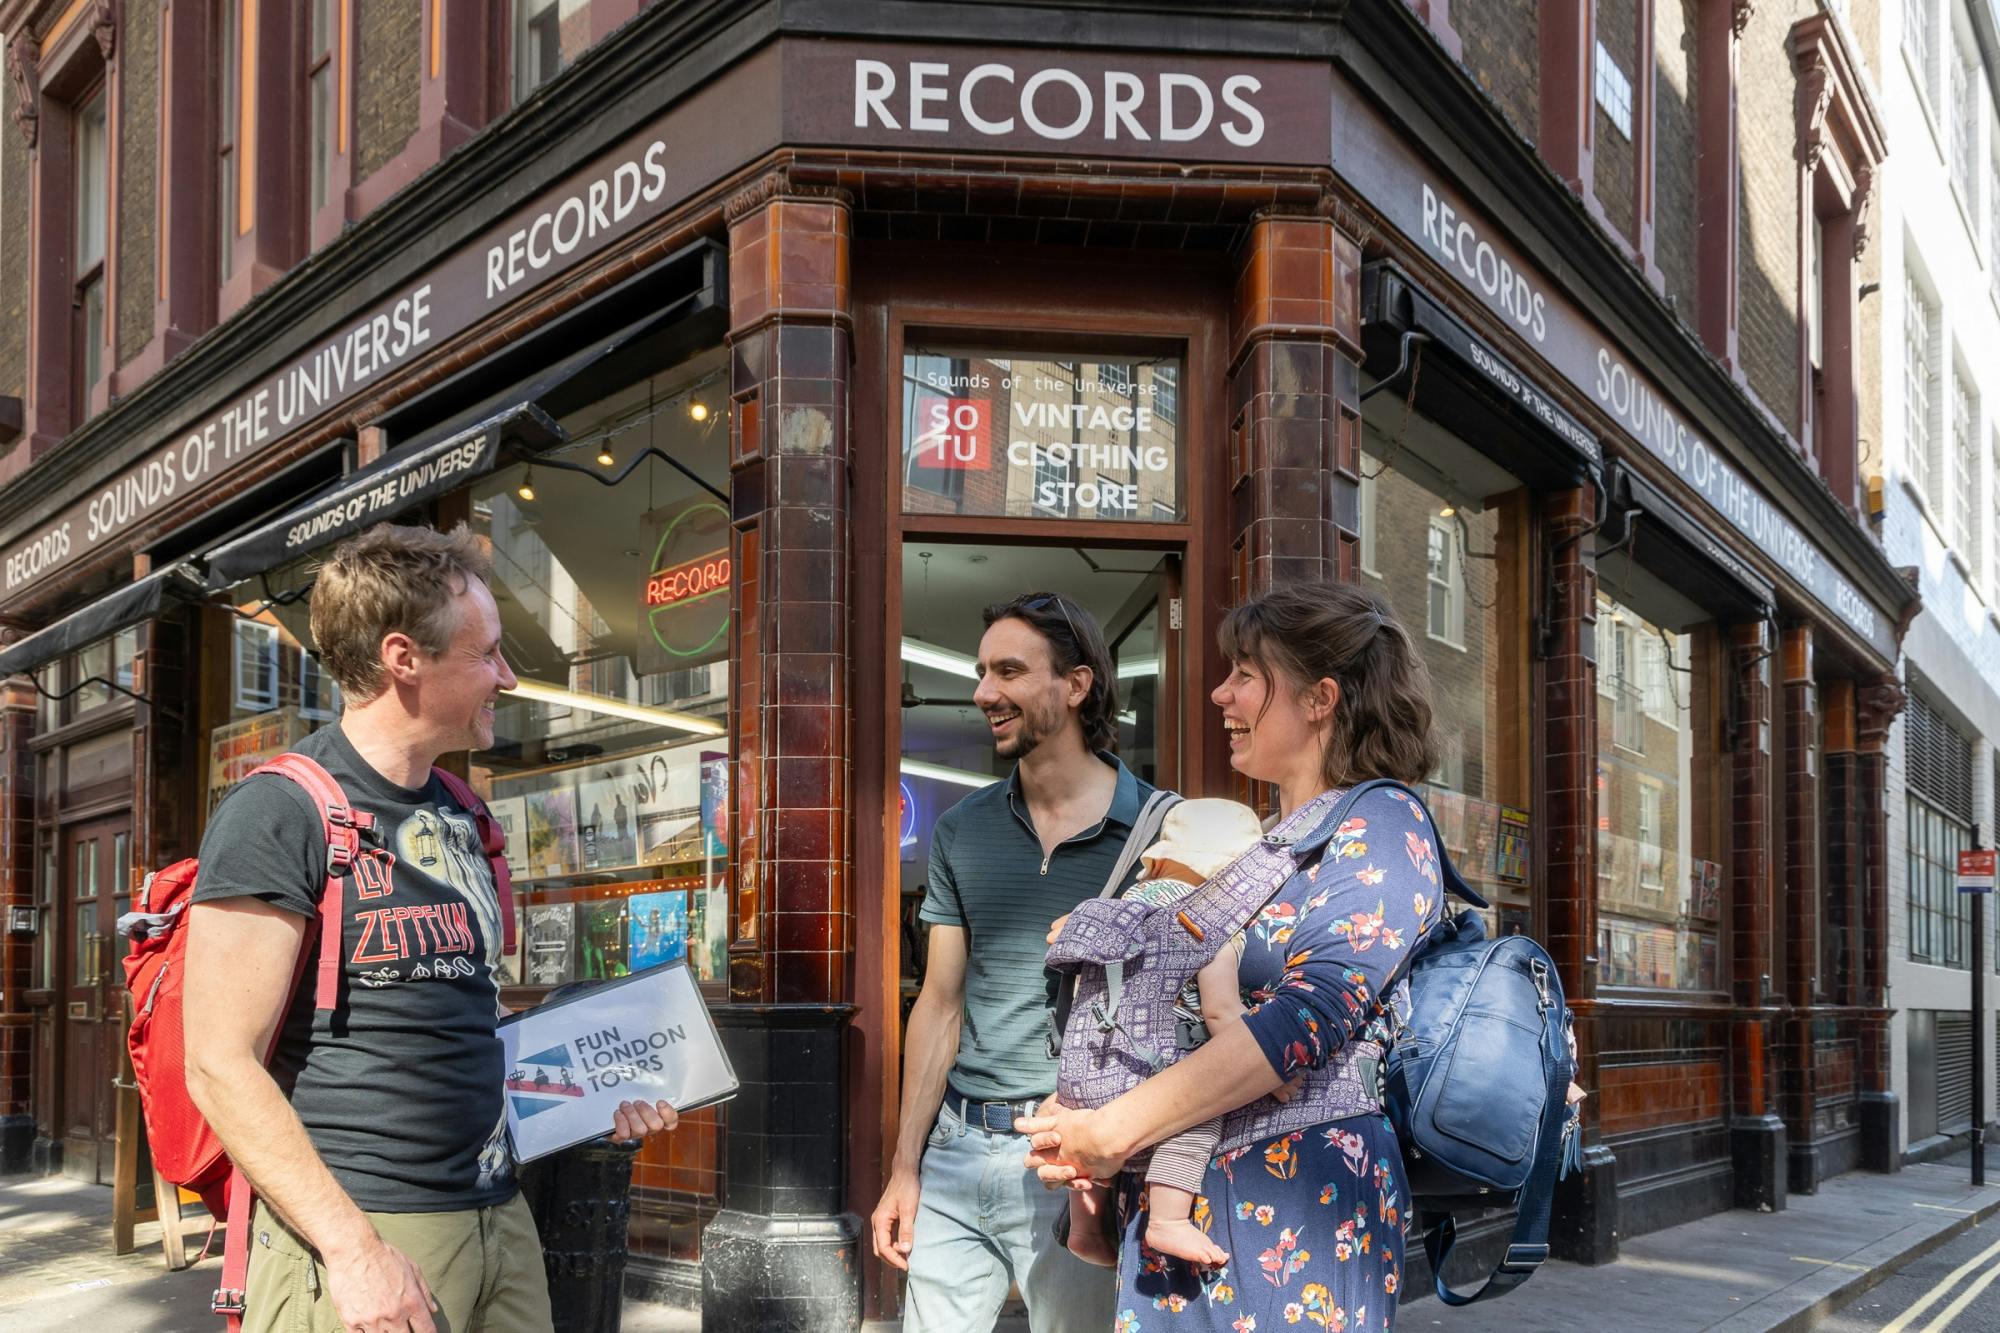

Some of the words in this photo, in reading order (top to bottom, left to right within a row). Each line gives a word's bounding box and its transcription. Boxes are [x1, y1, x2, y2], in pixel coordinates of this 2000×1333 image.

[854, 59, 1265, 147] RECORDS
[486, 141, 666, 299] RECORDS
[1422, 183, 1546, 342] RECORDS
[927, 371, 990, 388] Sounds
[1002, 375, 1022, 388] of
[1034, 378, 1064, 392] the
[1075, 378, 1158, 395] Universe
[87, 451, 175, 542] SOUNDS
[182, 429, 216, 482] OF
[222, 389, 270, 459] THE
[277, 285, 431, 425] UNIVERSE
[930, 404, 978, 431] SO
[1014, 402, 1152, 432] VINTAGE
[1532, 394, 1554, 424] THE
[935, 434, 977, 461] TU
[1007, 441, 1168, 471] CLOTHING
[1596, 348, 1687, 472] SOUNDS
[1692, 441, 1717, 496] OF
[1720, 466, 1749, 527] THE
[1753, 497, 1816, 587] UNIVERSE
[286, 503, 346, 548] SOUNDS
[346, 495, 367, 522] OF
[368, 479, 398, 513] THE
[399, 435, 487, 497] UNIVERSE
[1039, 481, 1138, 510] STORE
[6, 523, 71, 590] RECORDS
[647, 559, 730, 604] RECORD
[1835, 579, 1875, 639] RECORDS
[351, 902, 475, 963] ZEPPELIN
[574, 1026, 621, 1055] FUN
[581, 1024, 687, 1073] LONDON
[587, 1054, 664, 1092] TOURS
